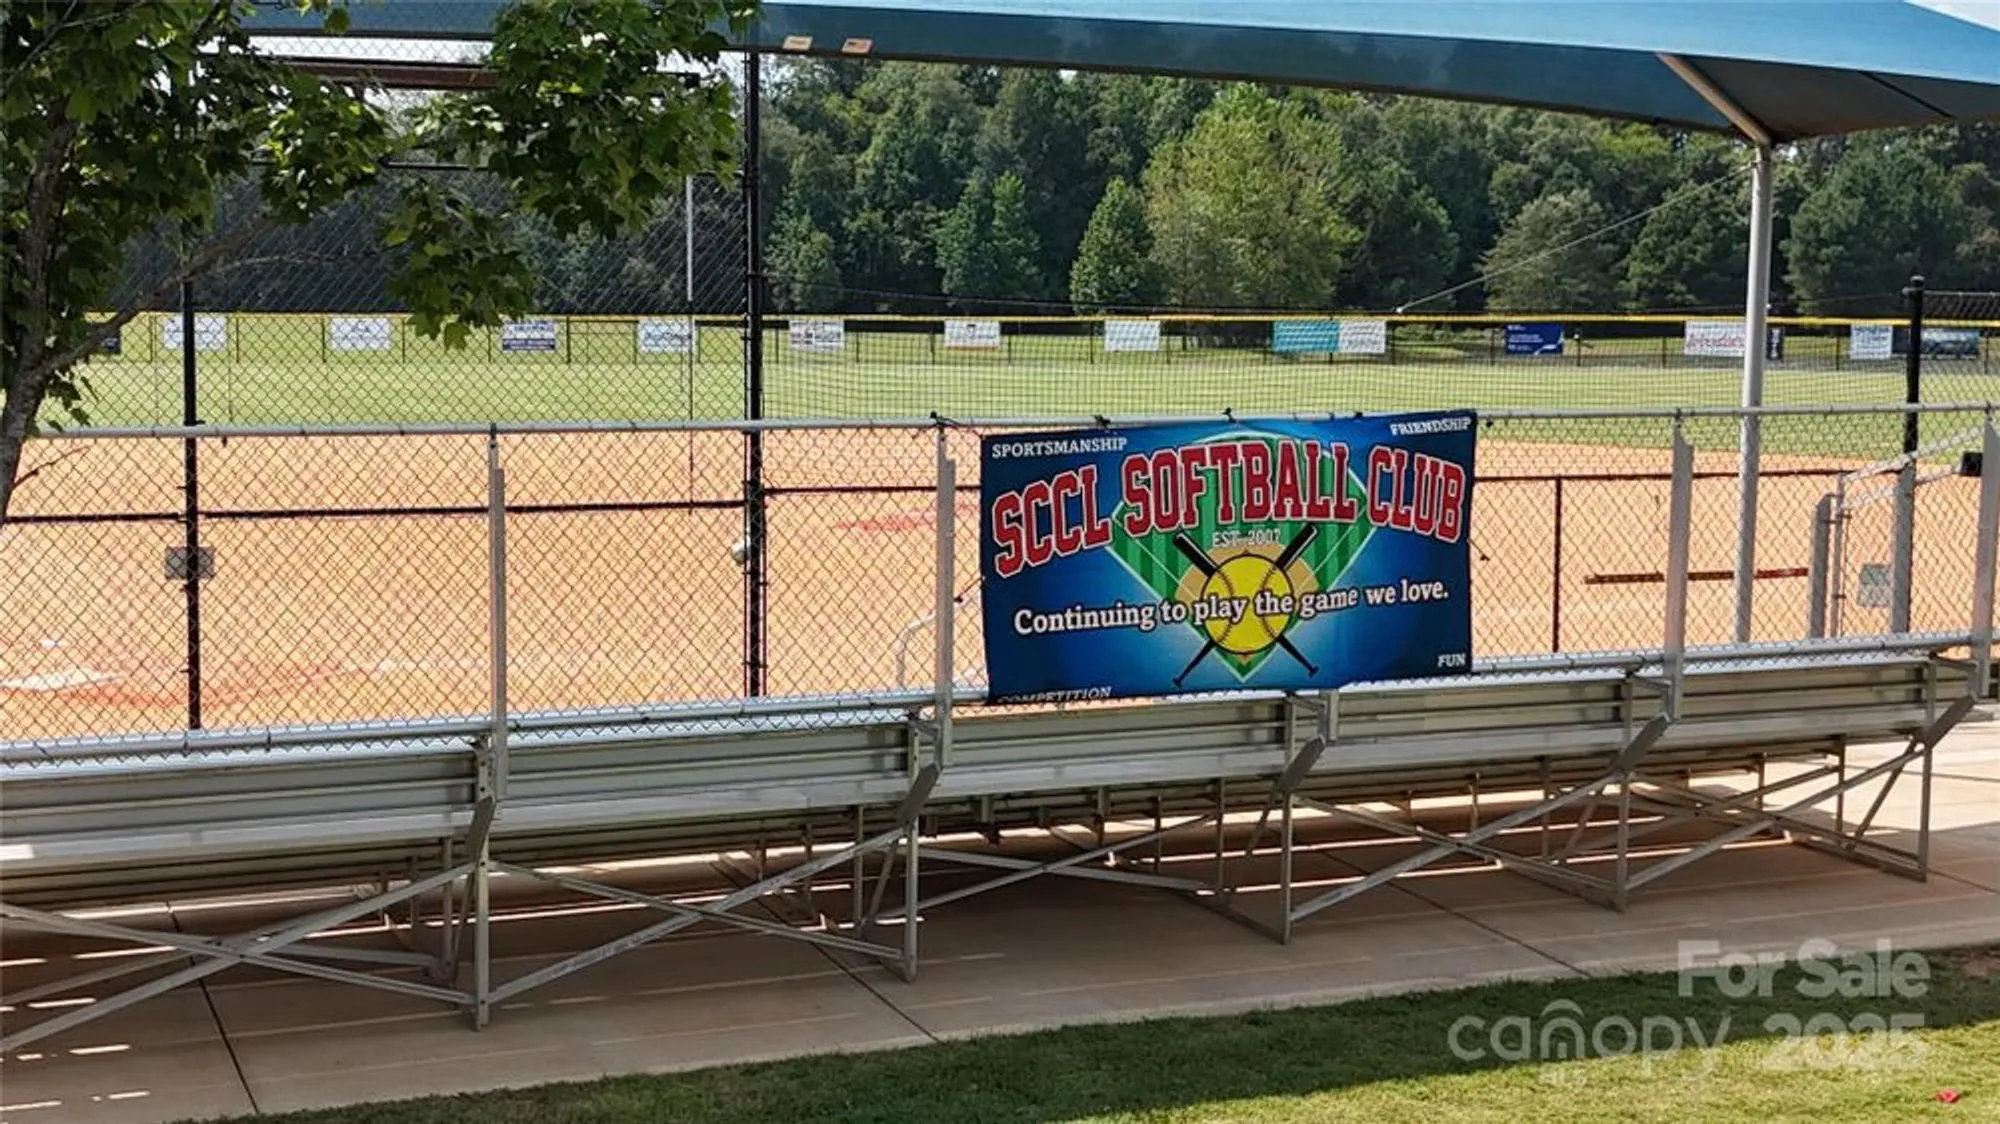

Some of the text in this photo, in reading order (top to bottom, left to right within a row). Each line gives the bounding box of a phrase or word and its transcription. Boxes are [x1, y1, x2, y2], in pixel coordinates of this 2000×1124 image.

[1390, 416, 1471, 435] FRIENDSHIP
[992, 438, 1128, 458] SPORTSMANSHIP
[993, 440, 1465, 578] SCCL SOFTBALL CLUB
[1014, 578, 1450, 634] Continuing to play the game we love.
[1437, 653, 1466, 668] FUN
